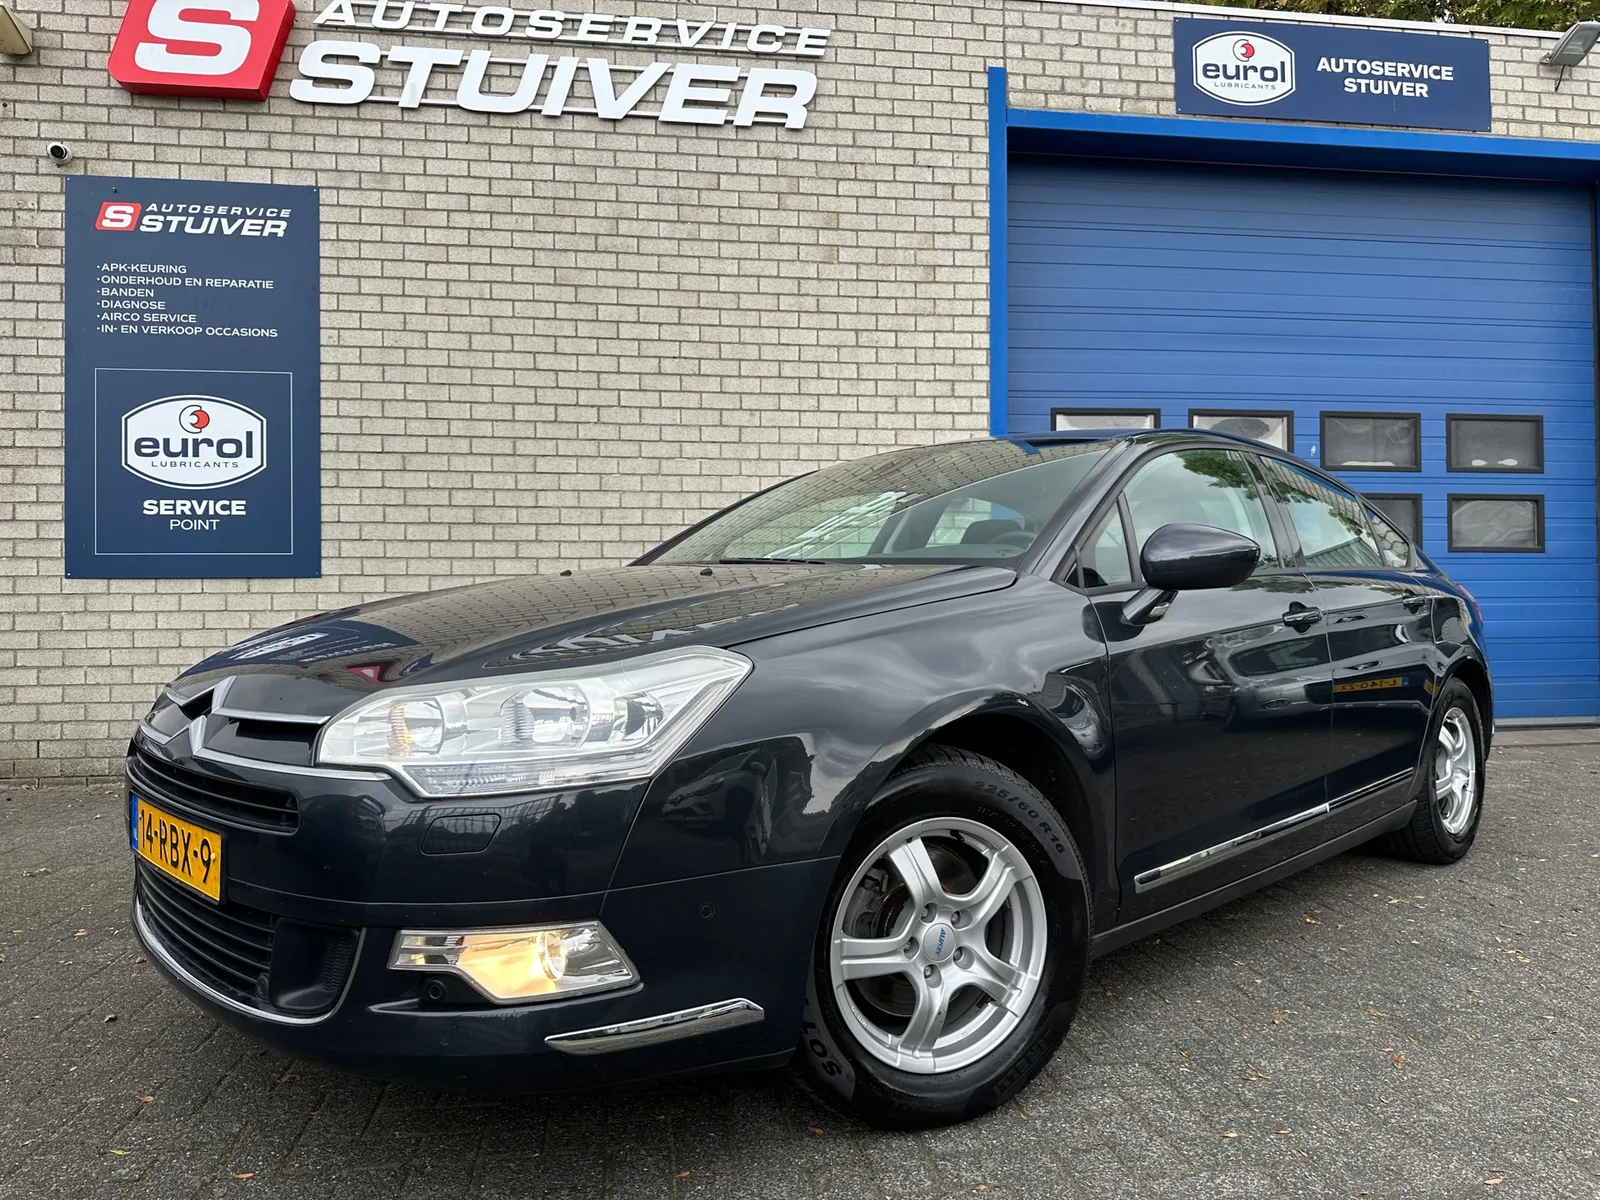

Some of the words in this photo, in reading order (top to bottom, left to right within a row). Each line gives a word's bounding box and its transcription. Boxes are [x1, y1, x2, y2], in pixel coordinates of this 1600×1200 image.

[313, 0, 831, 56] AUTOSERVICE
[134, 0, 260, 76] S
[1201, 59, 1286, 83] eurol
[1316, 56, 1454, 81] AUTOSERVICE
[289, 40, 818, 129] STUIVER
[1213, 81, 1277, 90] LUBRICANTS
[1343, 78, 1429, 98] STUIVER
[101, 205, 136, 228] S
[146, 203, 292, 218] AUTOSERVICE
[139, 214, 288, 238] STUIVER
[101, 263, 187, 274] APK-KEURING
[101, 275, 182, 287] ONDERHOUD
[185, 277, 202, 287] EN
[205, 278, 274, 289] REPARATIE
[101, 288, 154, 298] BANDEN
[101, 300, 166, 310] DIAGNOSE
[101, 312, 140, 322] AIRCO
[143, 313, 197, 323] SERVICE
[101, 325, 118, 333] IN-
[121, 325, 138, 334] EN
[141, 326, 203, 336] VERKOOP
[205, 327, 278, 338] OCCASIONS
[134, 430, 254, 459] eurol
[151, 460, 239, 469] LUBRICANTS
[143, 499, 247, 516] SERVICE
[169, 519, 220, 531] POINT
[139, 809, 212, 884] 14-RBX-9
